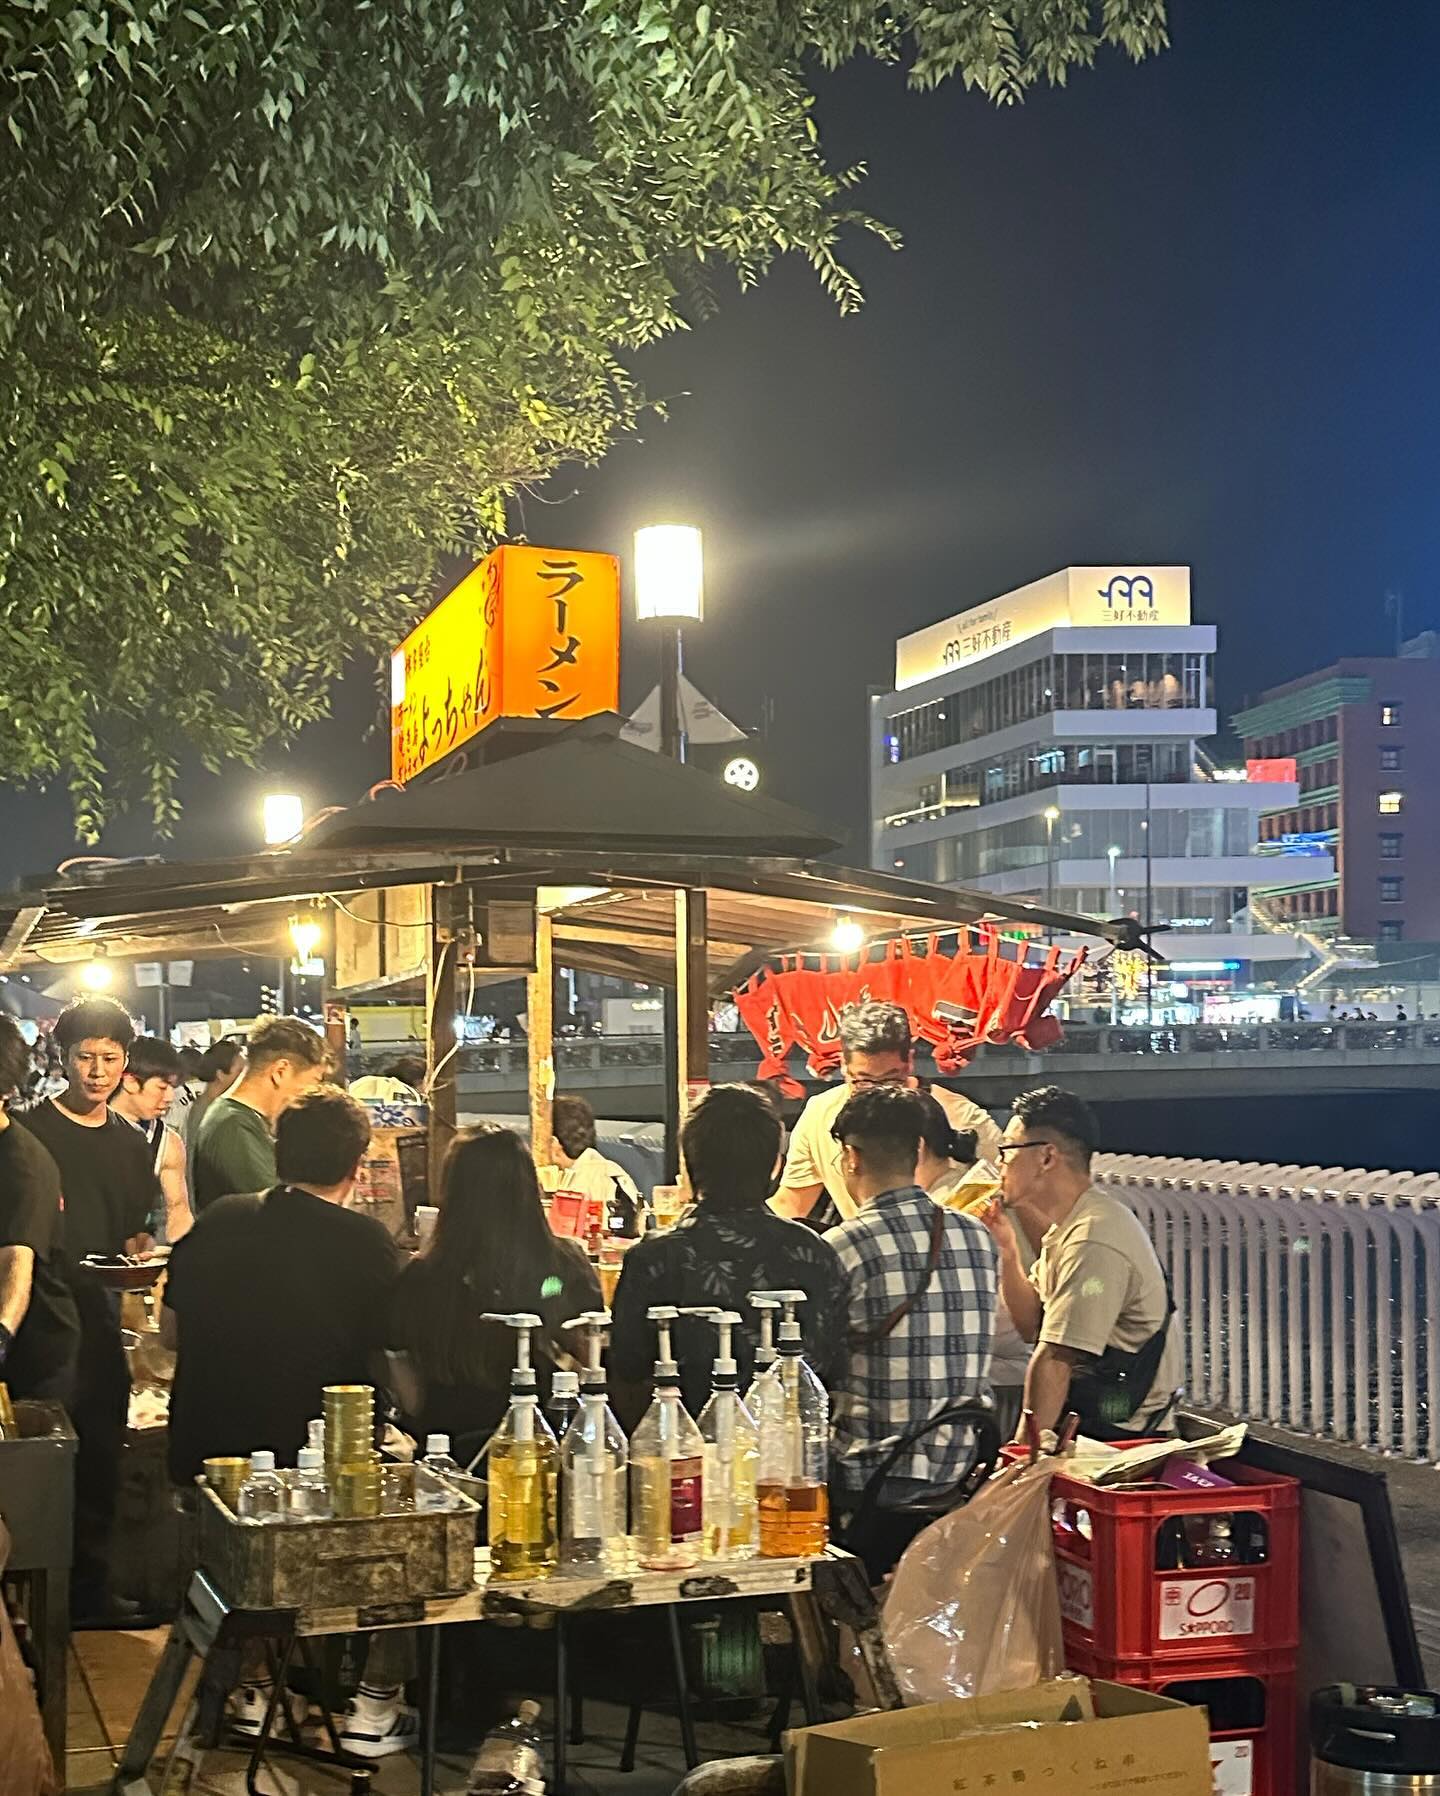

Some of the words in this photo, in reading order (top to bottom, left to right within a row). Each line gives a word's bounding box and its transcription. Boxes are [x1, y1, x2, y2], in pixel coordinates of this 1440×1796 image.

[535, 560, 584, 718] ラーメン
[962, 621, 1012, 657] 三好不動産
[1102, 609, 1159, 622] 三好不動産
[419, 648, 490, 765] よっちゃん
